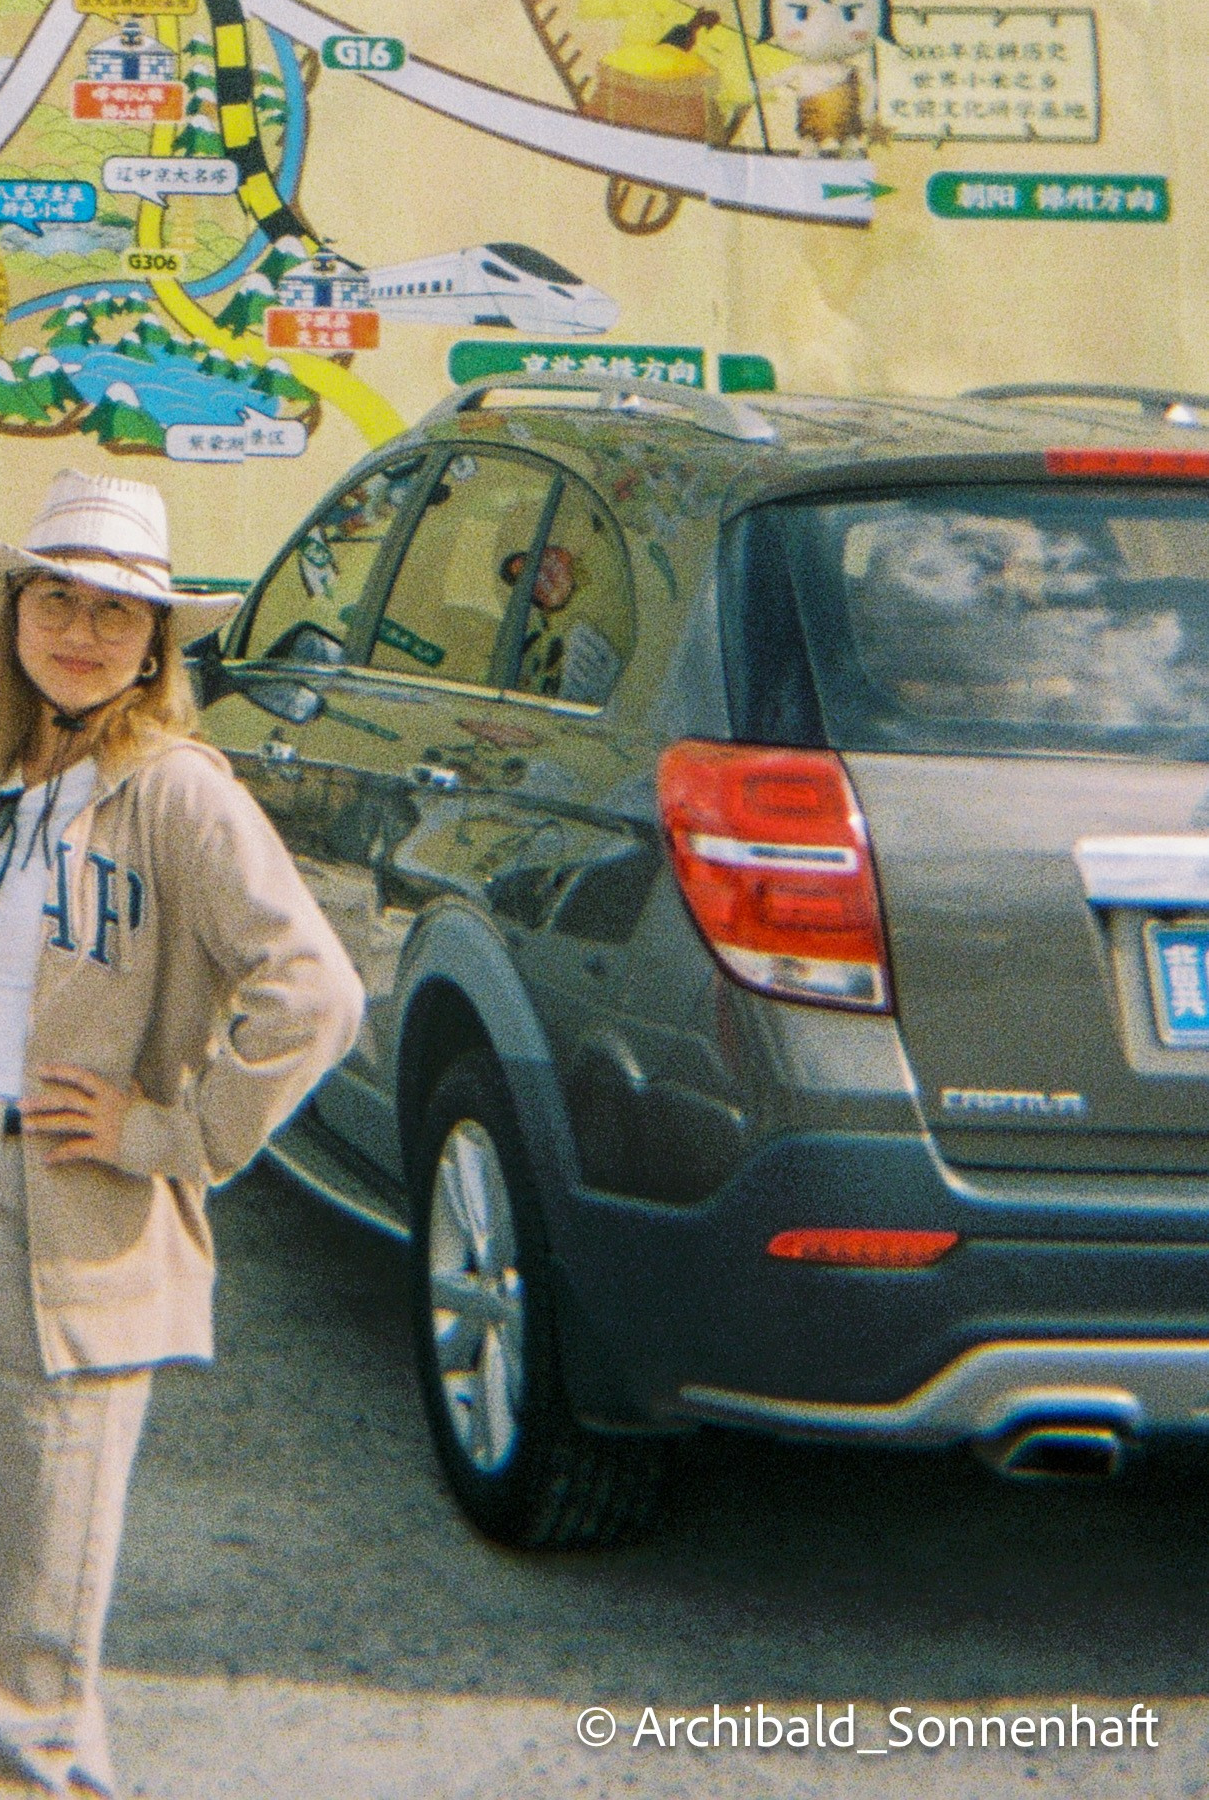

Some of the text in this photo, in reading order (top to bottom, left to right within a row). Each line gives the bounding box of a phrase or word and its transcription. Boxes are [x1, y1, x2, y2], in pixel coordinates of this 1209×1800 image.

[334, 40, 393, 67] G16
[116, 166, 229, 184] 辽中京大名塔
[956, 183, 1022, 210] 朝阳
[127, 253, 178, 270] G306
